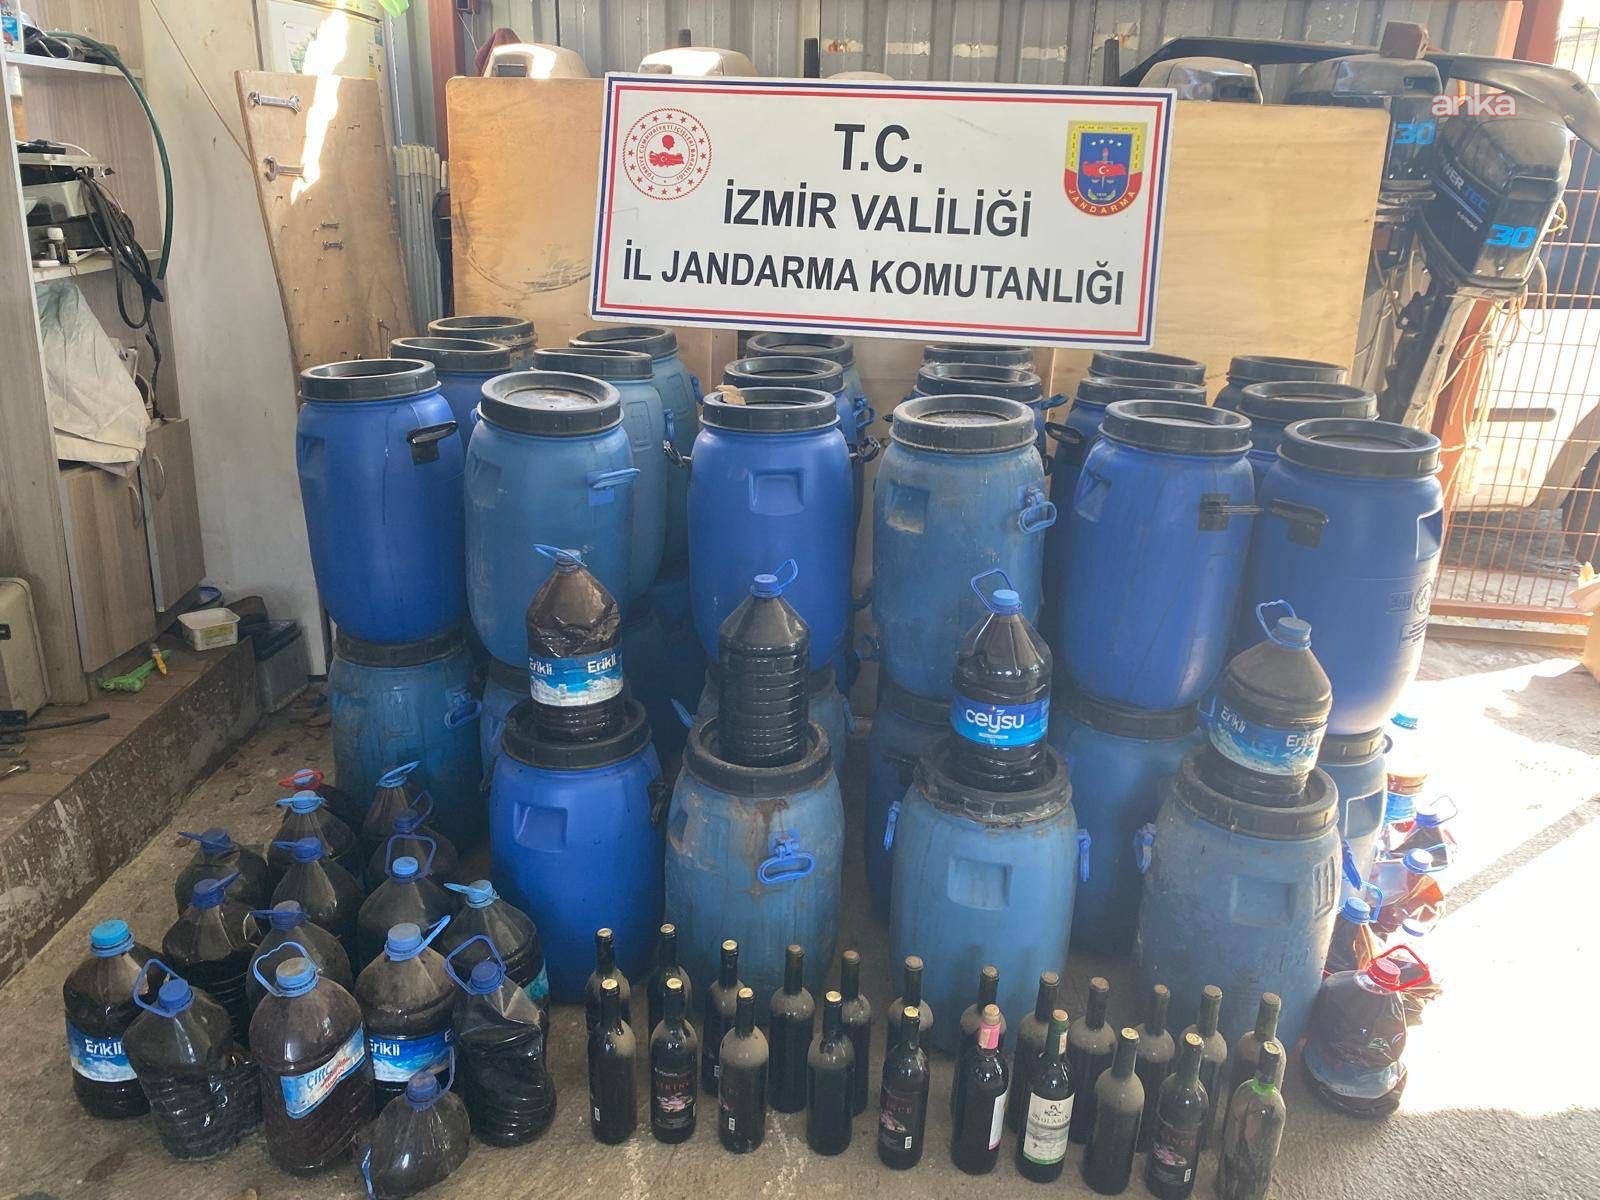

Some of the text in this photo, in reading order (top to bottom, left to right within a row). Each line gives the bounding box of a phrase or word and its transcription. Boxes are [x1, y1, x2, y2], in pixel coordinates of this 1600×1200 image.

[1394, 121, 1436, 145] 30
[834, 123, 923, 174] T.C.
[722, 178, 1032, 237] İZMİR VALİLİĞİ
[1068, 189, 1136, 214] JANDARMA
[1486, 223, 1537, 248] 30
[623, 239, 1125, 305] İL JANDARMA KOMUTANLIĞI
[587, 653, 617, 673] Erikli
[965, 709, 1024, 733] ceysu
[85, 1038, 122, 1056] Erikli
